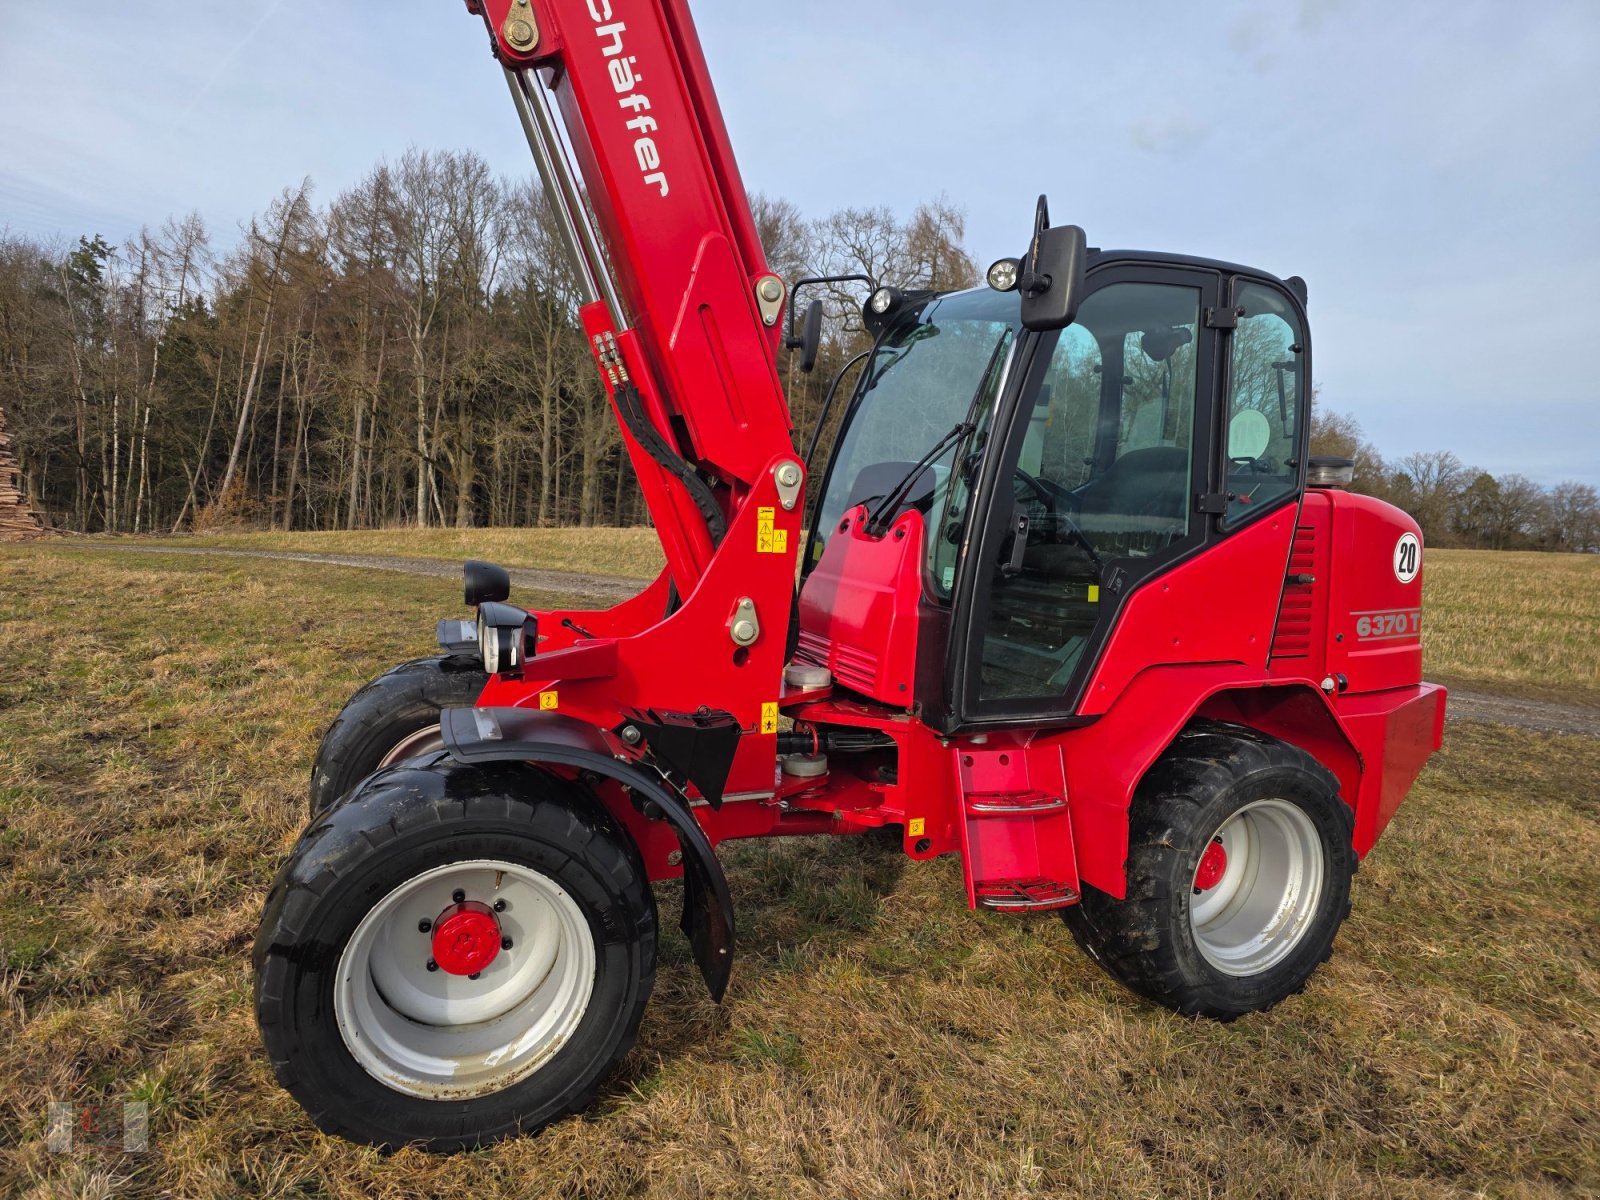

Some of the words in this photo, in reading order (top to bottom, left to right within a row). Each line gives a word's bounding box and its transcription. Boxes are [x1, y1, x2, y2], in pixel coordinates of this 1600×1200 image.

[1398, 542, 1416, 574] 20
[1356, 614, 1407, 637] 6370
[1410, 613, 1421, 631] T
